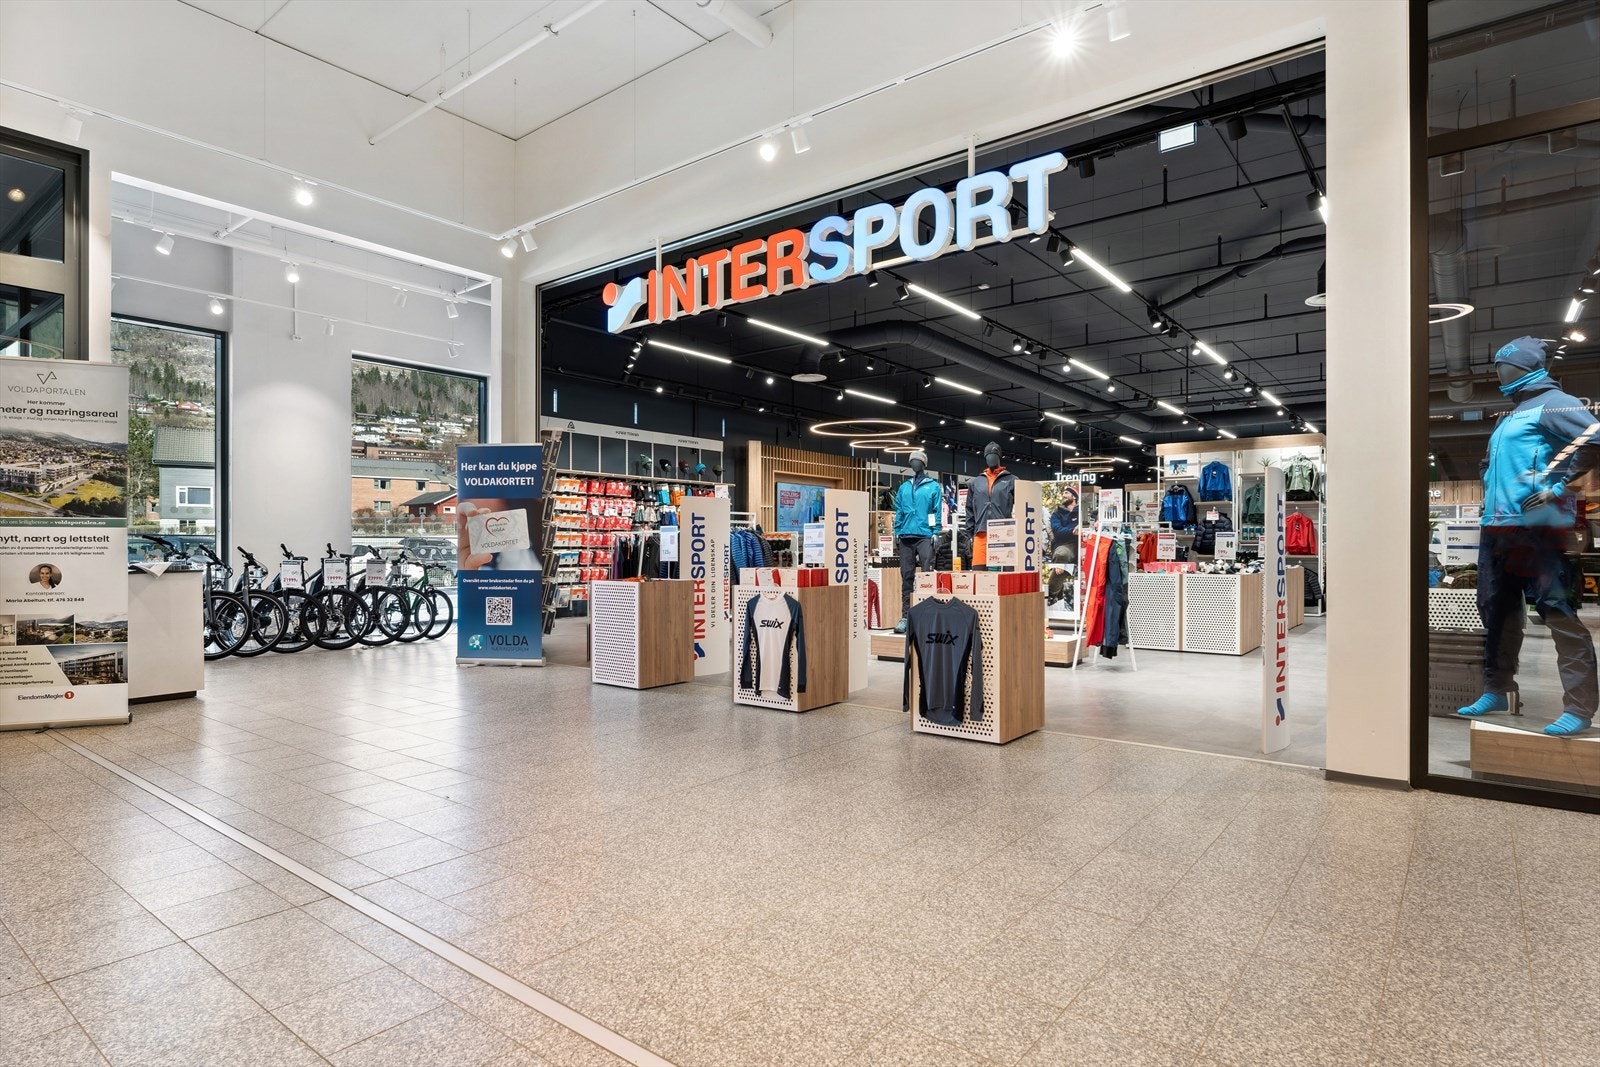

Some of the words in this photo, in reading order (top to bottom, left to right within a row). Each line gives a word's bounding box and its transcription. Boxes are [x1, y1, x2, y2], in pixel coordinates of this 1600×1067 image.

[646, 151, 1068, 325] INTERSPORT
[7, 385, 86, 396] VOLDAPORTALEN
[29, 408, 44, 417] og
[46, 408, 119, 419] næringsareal
[461, 462, 477, 471] Her
[479, 462, 495, 471] kan
[497, 462, 509, 471] du
[511, 461, 537, 472] kjøpe
[464, 477, 534, 486] VOLDAKORTET!
[1054, 472, 1096, 484] Trening
[53, 536, 67, 545] og
[480, 538, 518, 549] VOLDAKORTET
[1275, 493, 1286, 693] INTERSPORT
[488, 635, 529, 646] VOLDA
[853, 631, 858, 639] VI
[17, 693, 64, 701] EiendomsMegler
